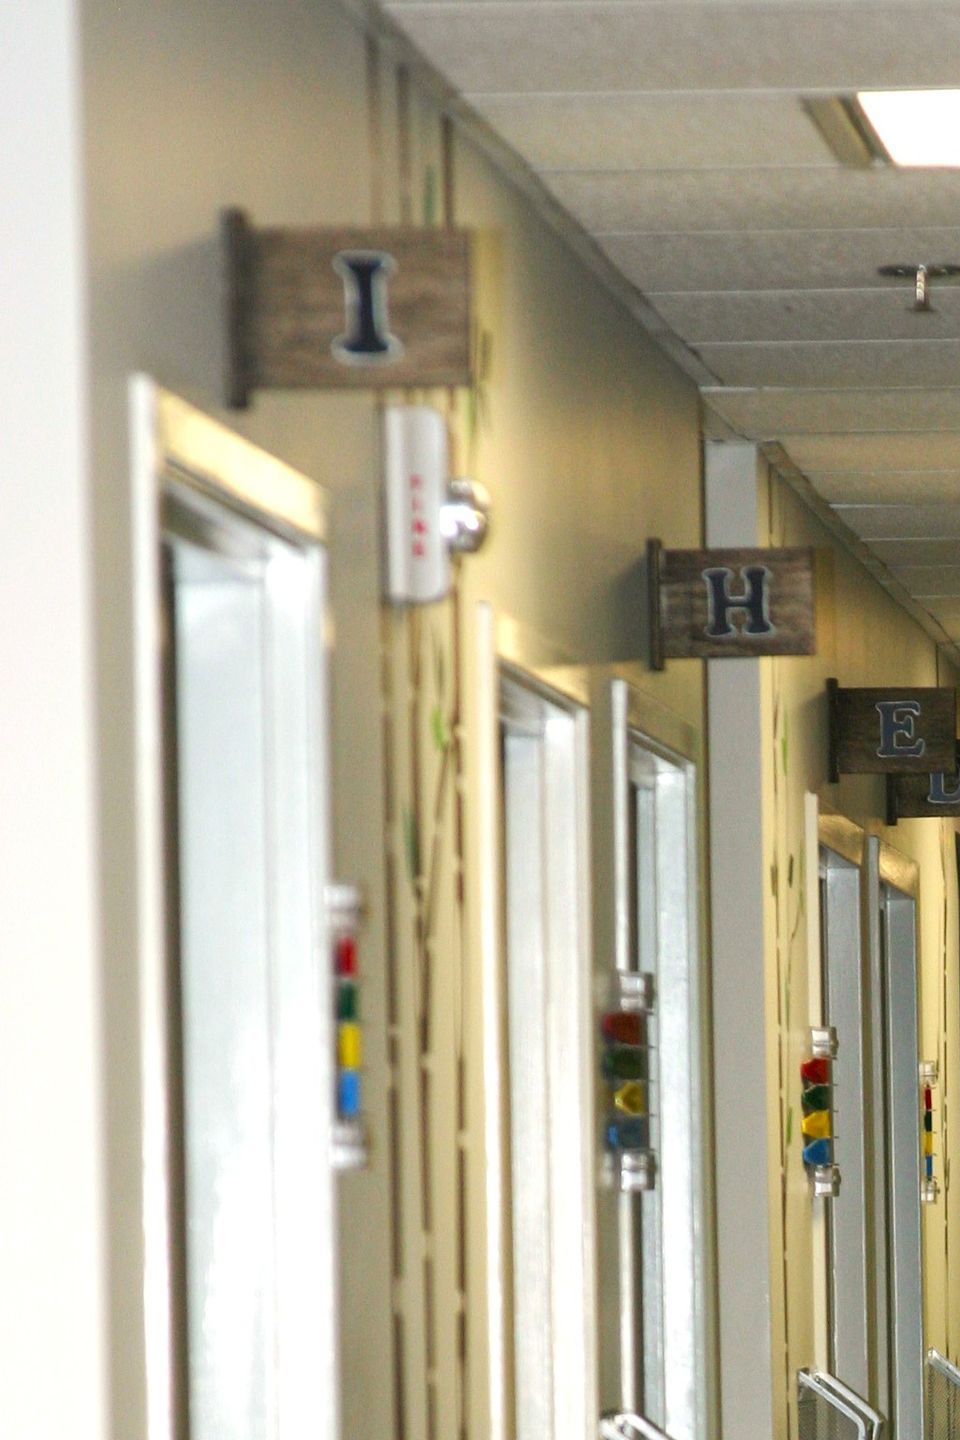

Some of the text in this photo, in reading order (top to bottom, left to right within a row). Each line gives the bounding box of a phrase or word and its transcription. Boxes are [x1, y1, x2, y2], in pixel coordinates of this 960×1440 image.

[332, 250, 404, 366] I
[702, 566, 775, 638] H
[875, 700, 926, 759] E
